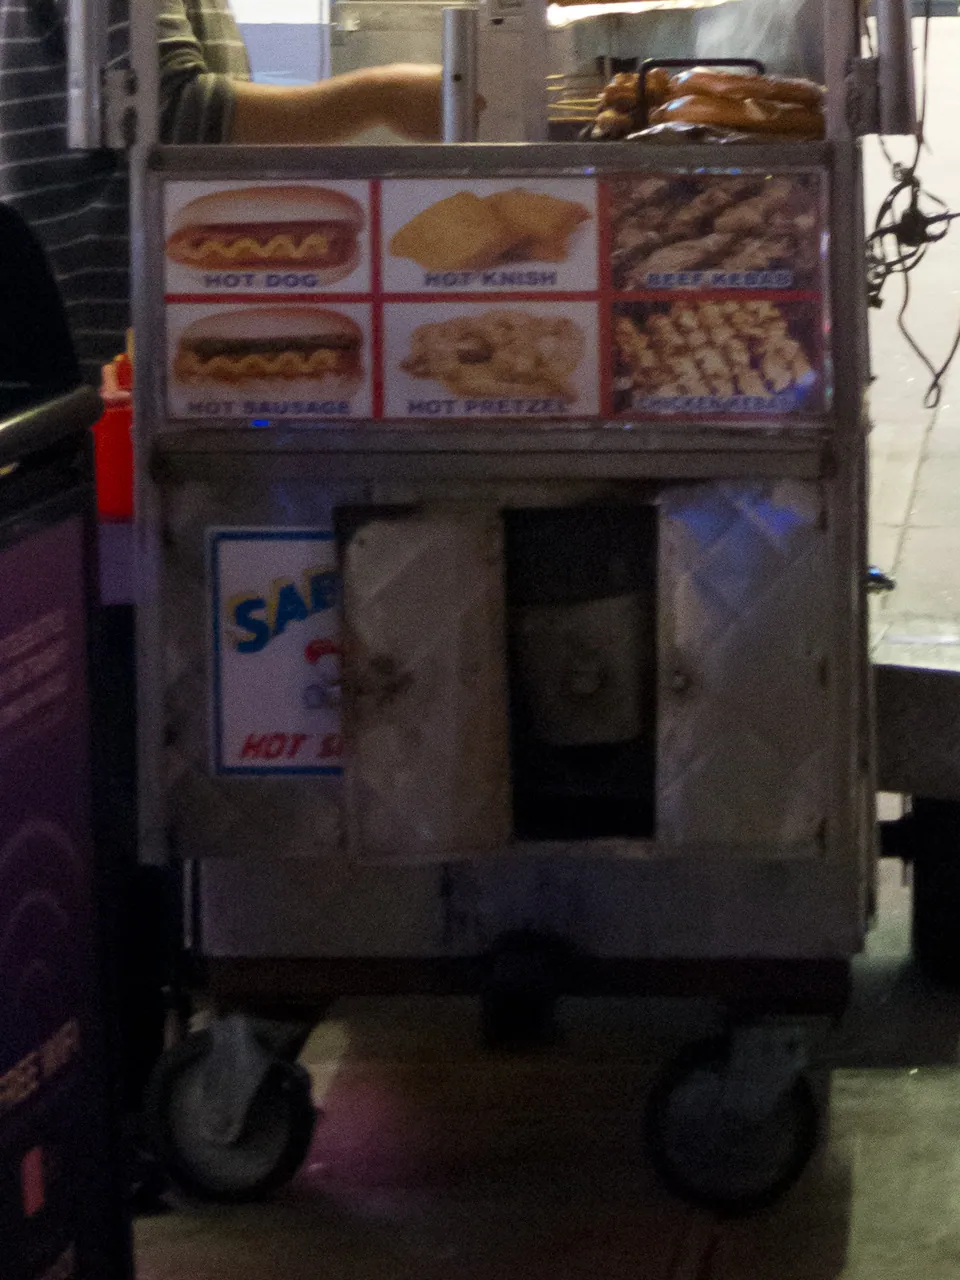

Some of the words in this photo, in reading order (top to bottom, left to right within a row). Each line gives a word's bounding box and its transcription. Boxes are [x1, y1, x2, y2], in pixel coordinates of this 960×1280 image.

[204, 274, 256, 288] HOT
[264, 273, 320, 288] DOG
[424, 272, 475, 287] HOT
[481, 270, 558, 286] KNISH
[647, 272, 702, 288] BEEF
[710, 270, 793, 288] KEBAB
[188, 401, 234, 415] HOT
[242, 400, 350, 415] SAUSAGE
[408, 399, 458, 414] HOT
[463, 398, 567, 414] PRETZEL
[240, 733, 307, 760] HOT
